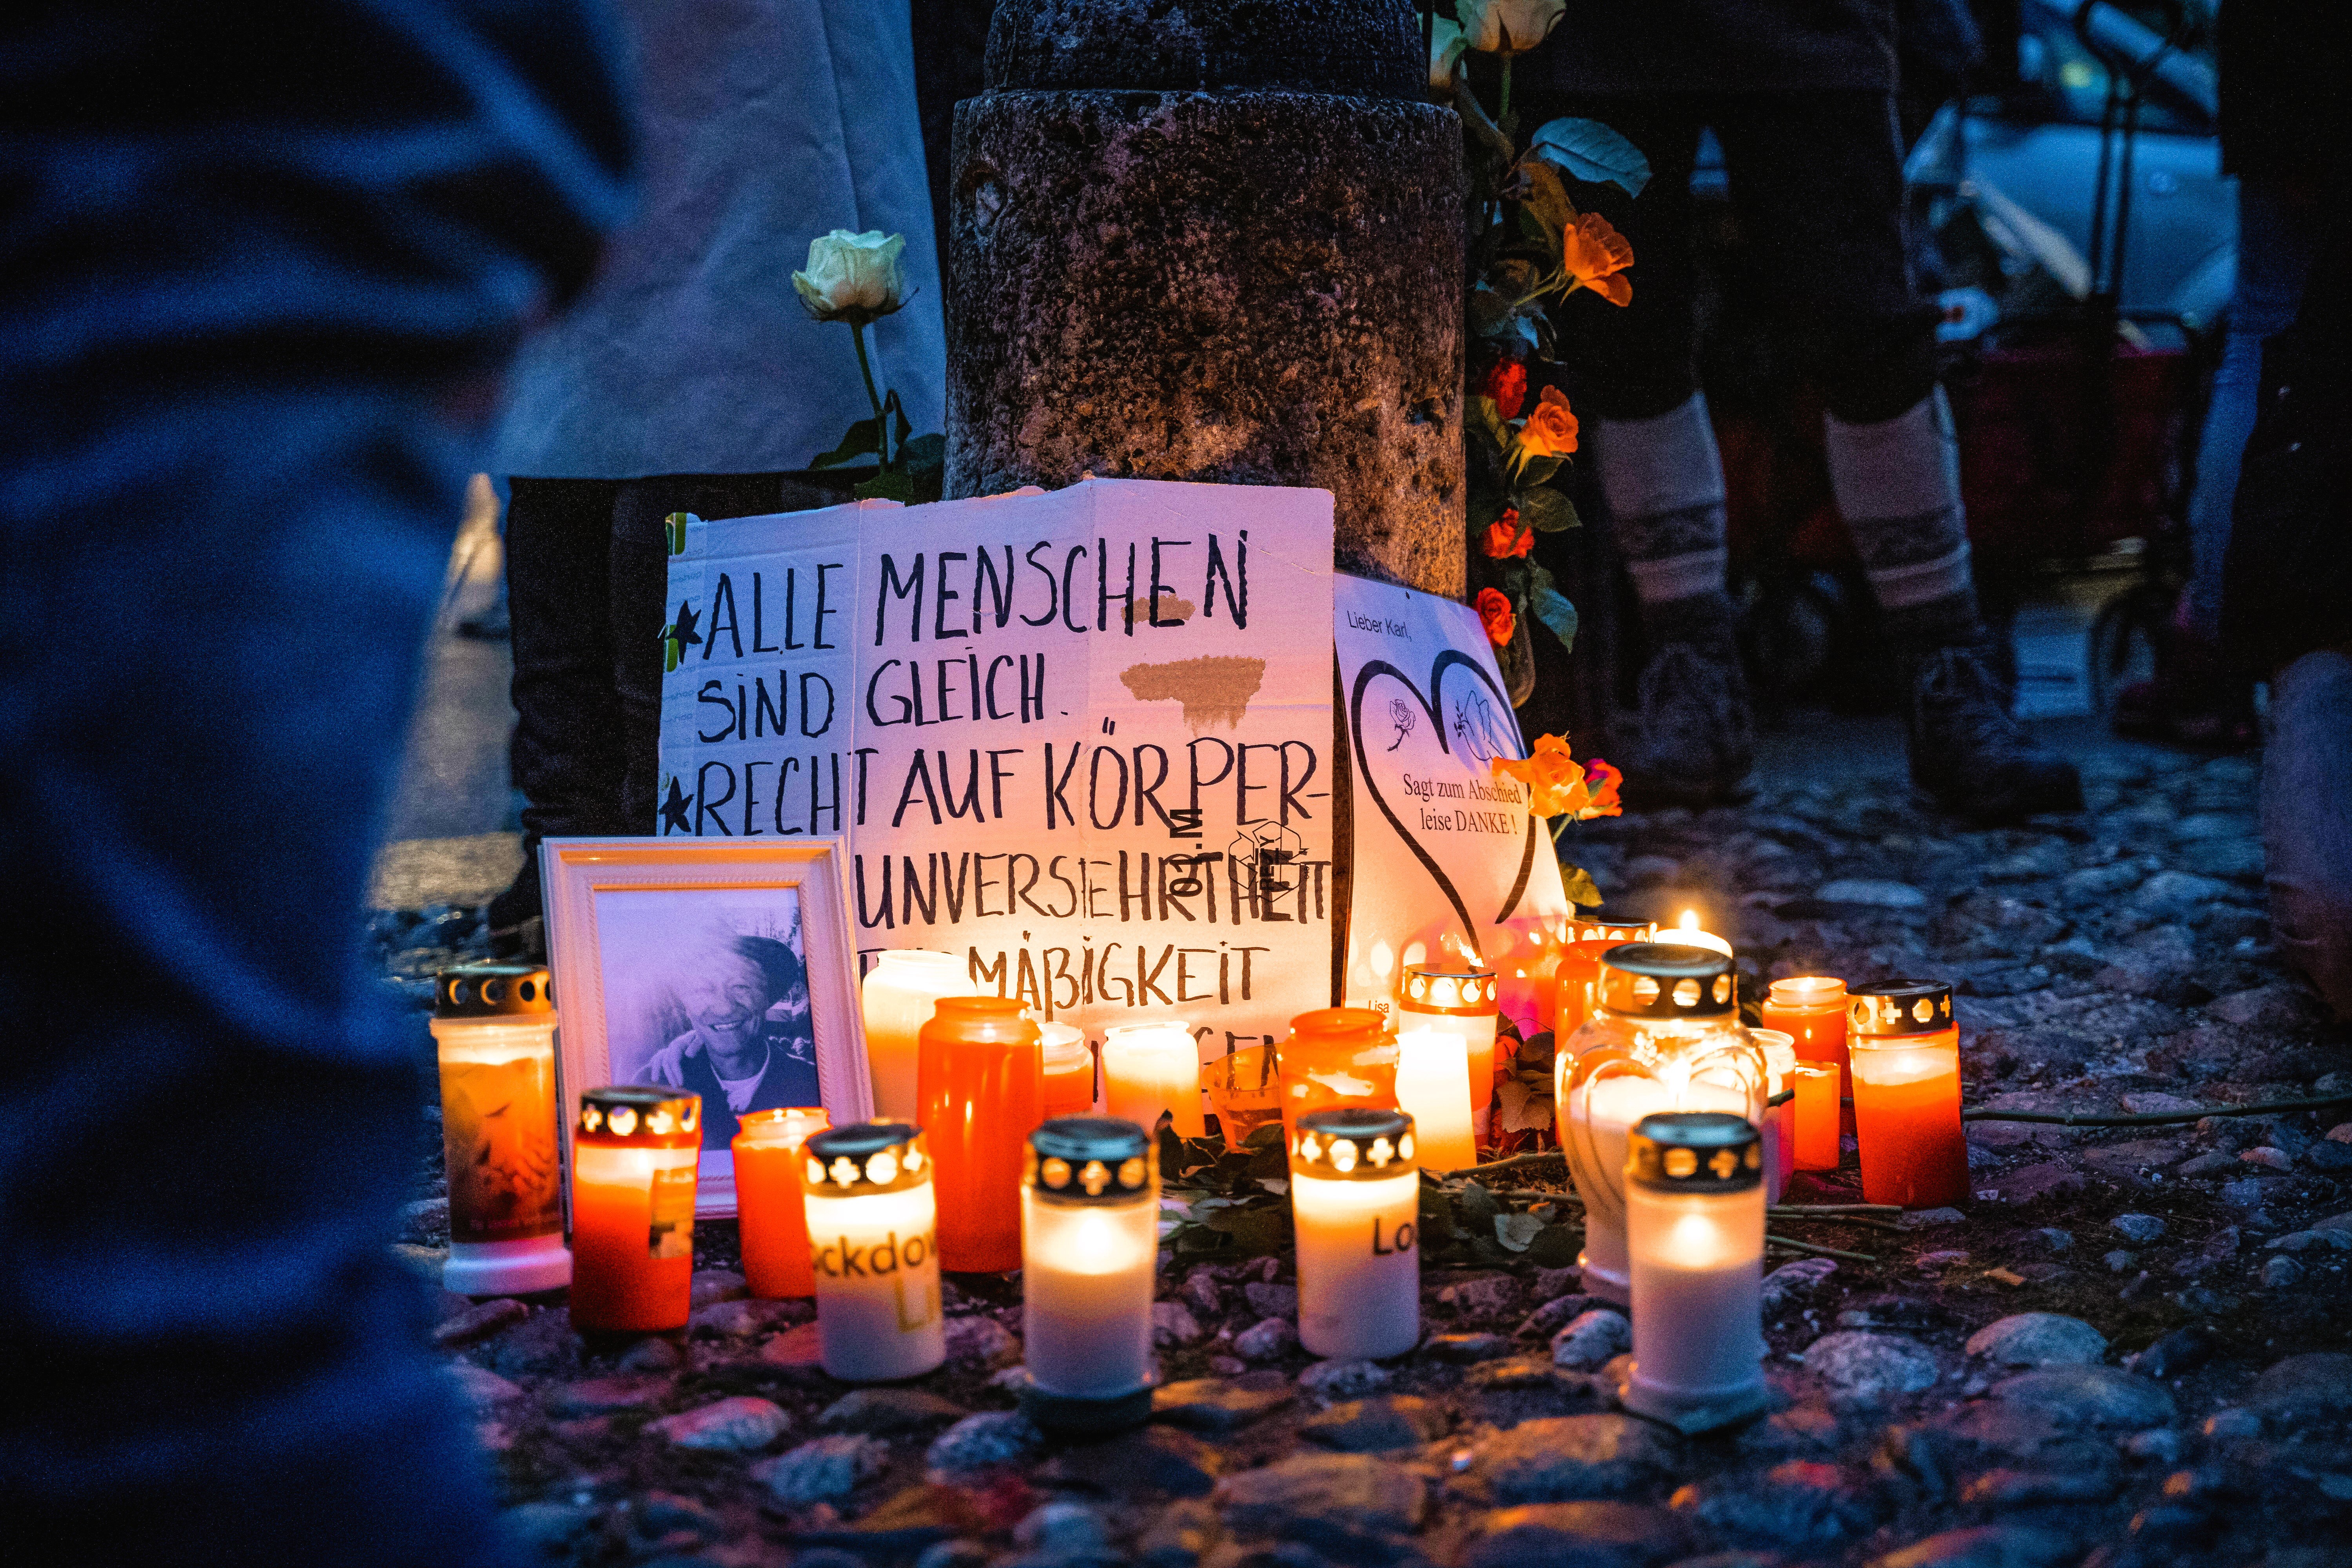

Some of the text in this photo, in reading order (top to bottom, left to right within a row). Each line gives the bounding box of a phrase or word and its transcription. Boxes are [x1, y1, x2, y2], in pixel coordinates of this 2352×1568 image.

[702, 530, 1248, 660] ALLE MENSCHEN
[1347, 610, 1412, 642] Lieber Karl,
[695, 717, 1331, 836] RECHT AUF KÖRPER-
[1403, 773, 1522, 804] Sagt zum Abschied
[1420, 808, 1518, 835] leise DANKE !
[814, 1230, 937, 1277] ckdo
[1373, 1218, 1418, 1255] Lo
